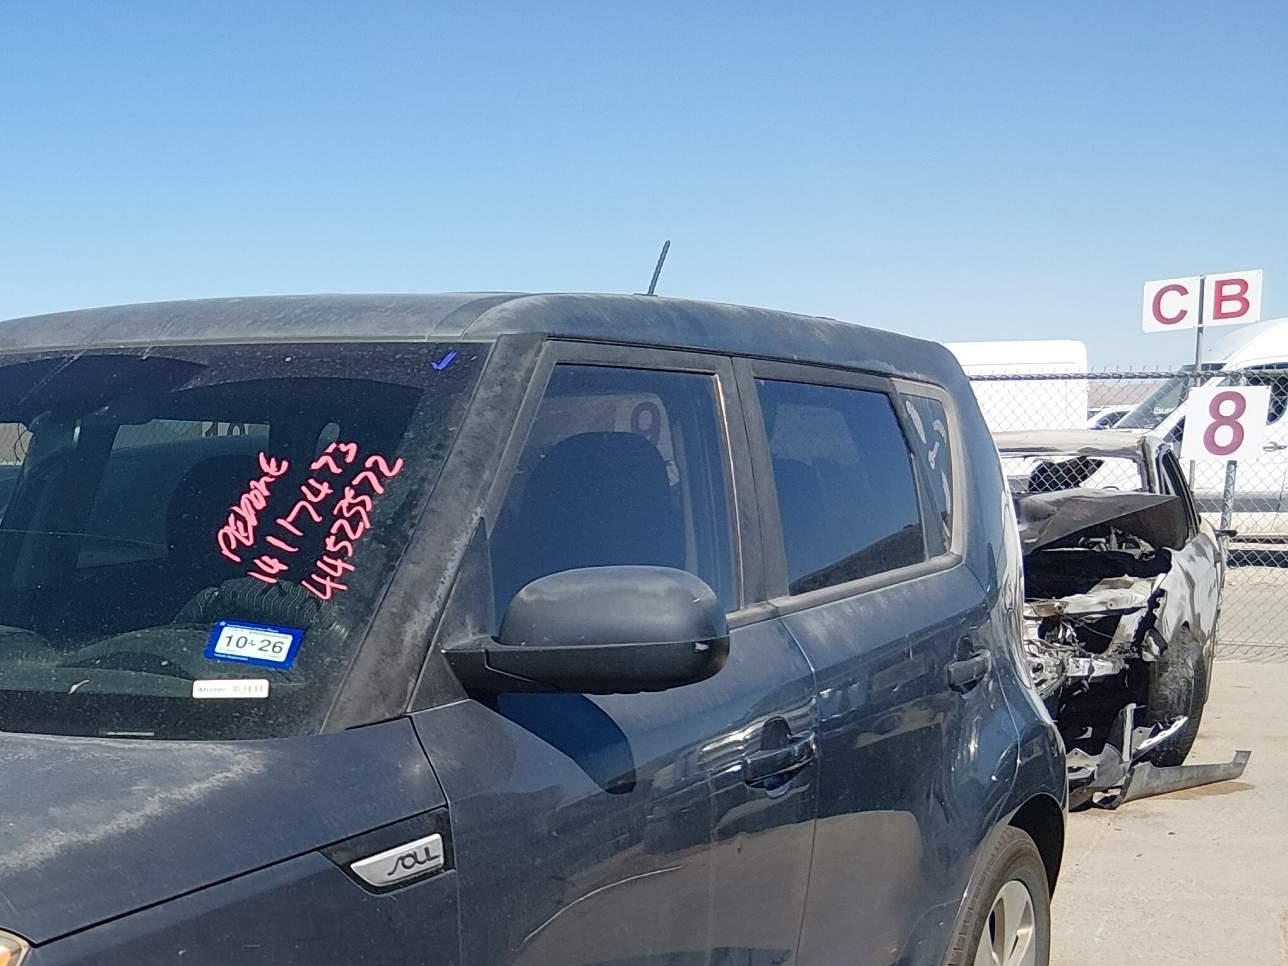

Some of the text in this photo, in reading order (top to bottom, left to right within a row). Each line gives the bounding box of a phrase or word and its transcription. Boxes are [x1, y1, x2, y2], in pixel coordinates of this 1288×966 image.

[1152, 284, 1189, 325] C
[1213, 278, 1250, 320] B
[1203, 391, 1246, 456] 8
[301, 454, 404, 600] 44523572
